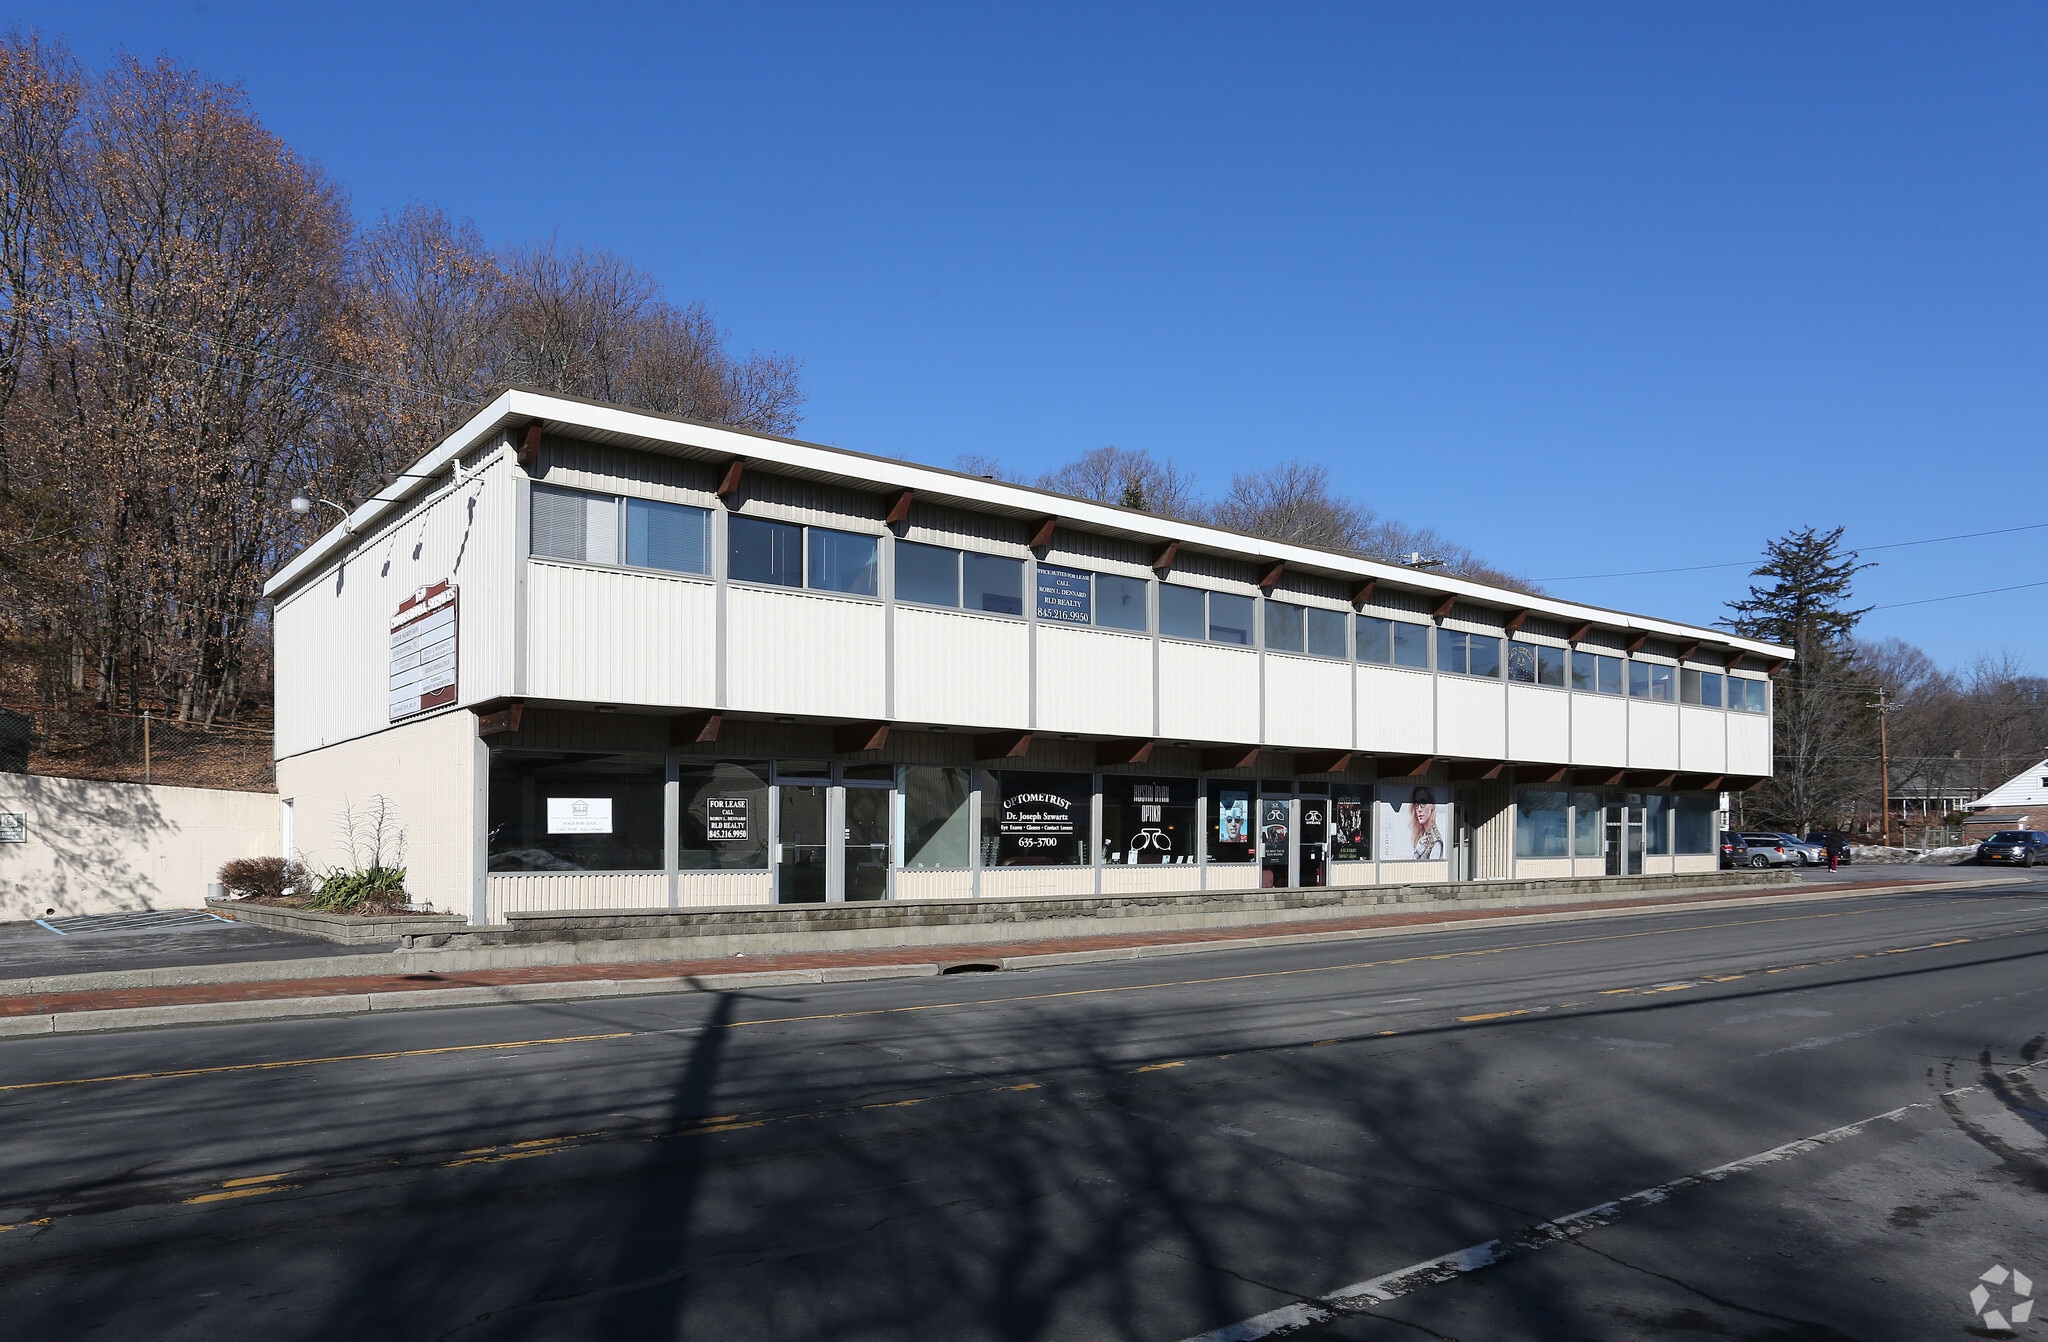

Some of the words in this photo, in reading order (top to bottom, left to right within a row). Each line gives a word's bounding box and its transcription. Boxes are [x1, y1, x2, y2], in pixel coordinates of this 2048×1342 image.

[1061, 590, 1086, 598] DENNARD
[1044, 596, 1056, 604] RLD
[1057, 598, 1082, 608] REALTY
[1037, 606, 1088, 622] 845.216.9950
[1134, 784, 1154, 802] AUSTIN
[1004, 793, 1072, 810] OPTOMETRIST
[1006, 812, 1018, 820] Dr.
[1019, 812, 1042, 822] Joseph
[1042, 812, 1068, 820] Szwartz
[1142, 804, 1161, 822] OPTIKA
[709, 830, 746, 838] 845.216.9950
[1018, 837, 1058, 848] 635-3700
